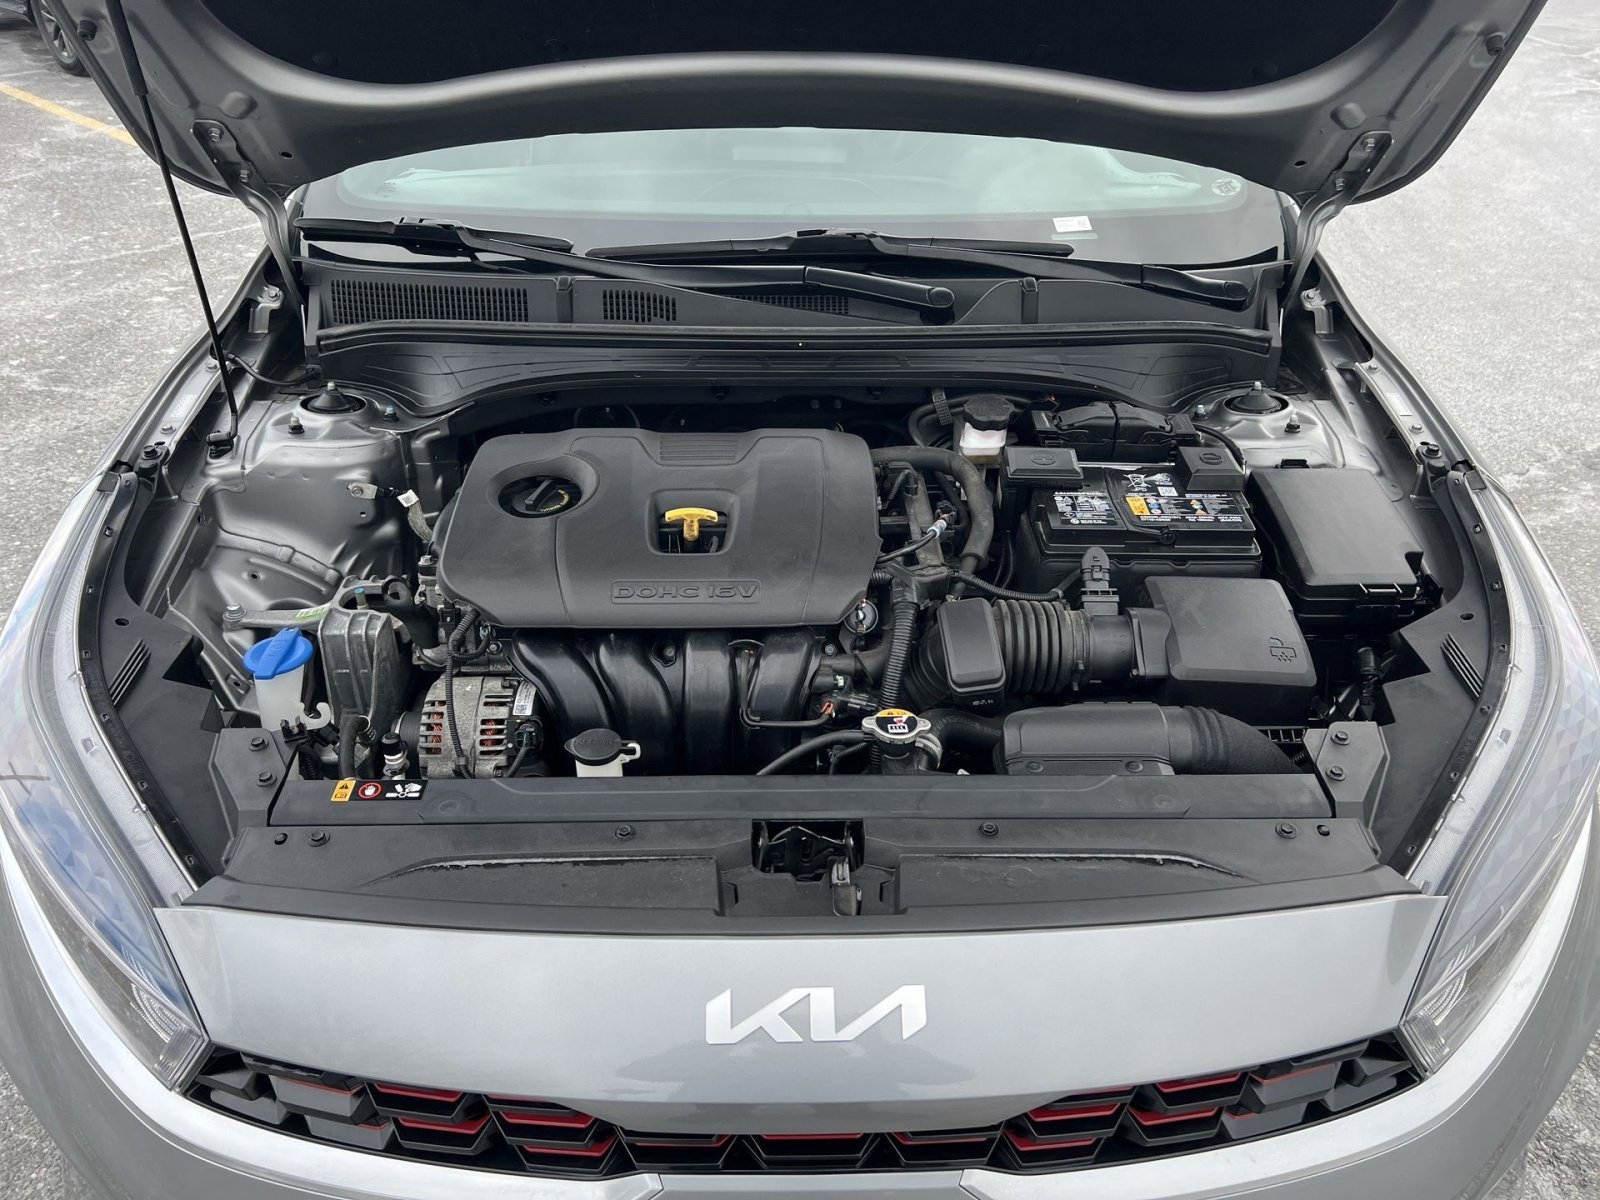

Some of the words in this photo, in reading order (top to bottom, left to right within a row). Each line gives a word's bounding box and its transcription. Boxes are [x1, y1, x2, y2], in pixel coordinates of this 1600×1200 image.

[614, 585, 700, 599] DOHC
[706, 585, 758, 599] 16V
[705, 984, 928, 1045] KIA
